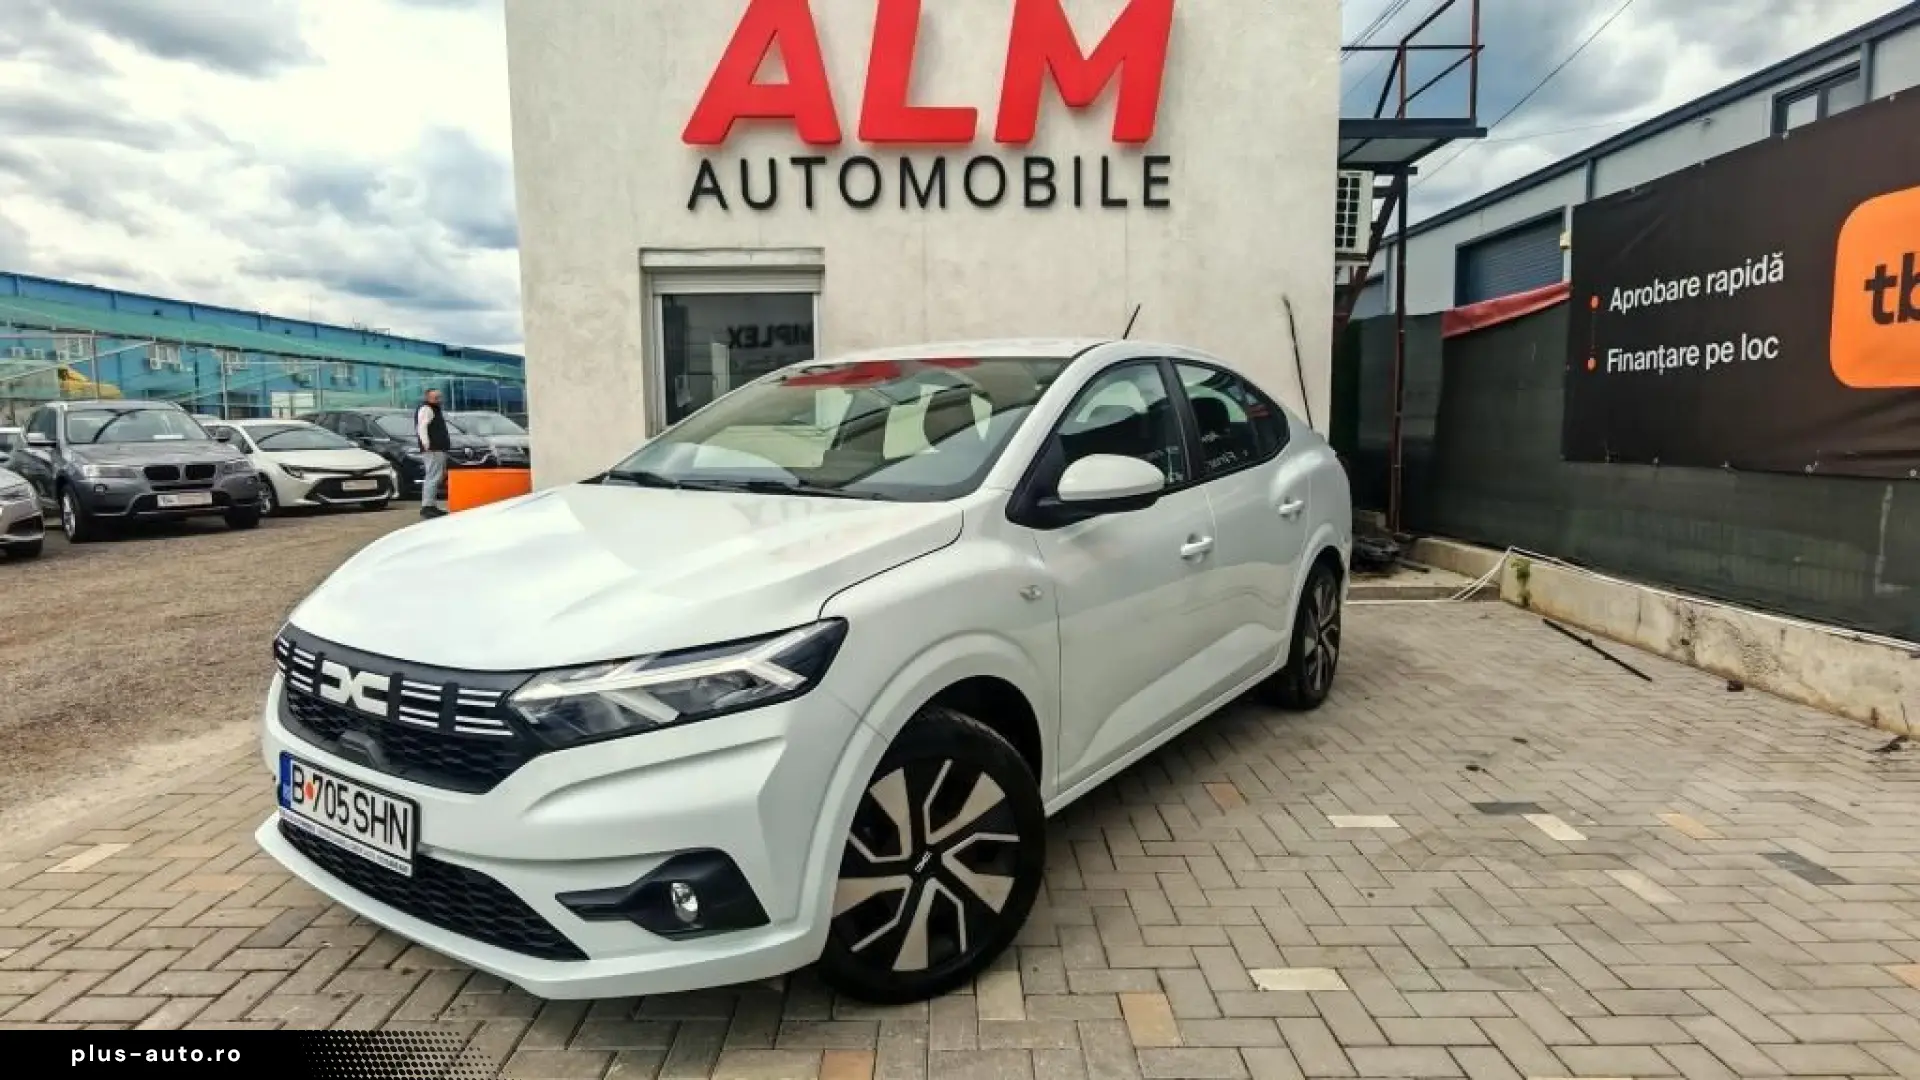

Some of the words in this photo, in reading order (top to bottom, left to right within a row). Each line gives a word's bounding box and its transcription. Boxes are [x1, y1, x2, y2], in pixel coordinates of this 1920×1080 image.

[682, 0, 1175, 144] ALM
[687, 155, 1171, 210] AUTOMOBILE
[1609, 275, 1700, 315] Aprobare
[1706, 251, 1784, 296] rapidă
[1607, 344, 1700, 375] Finanțare
[1705, 341, 1735, 370] pe
[1740, 332, 1780, 361] loc
[354, 790, 408, 850] SHN
